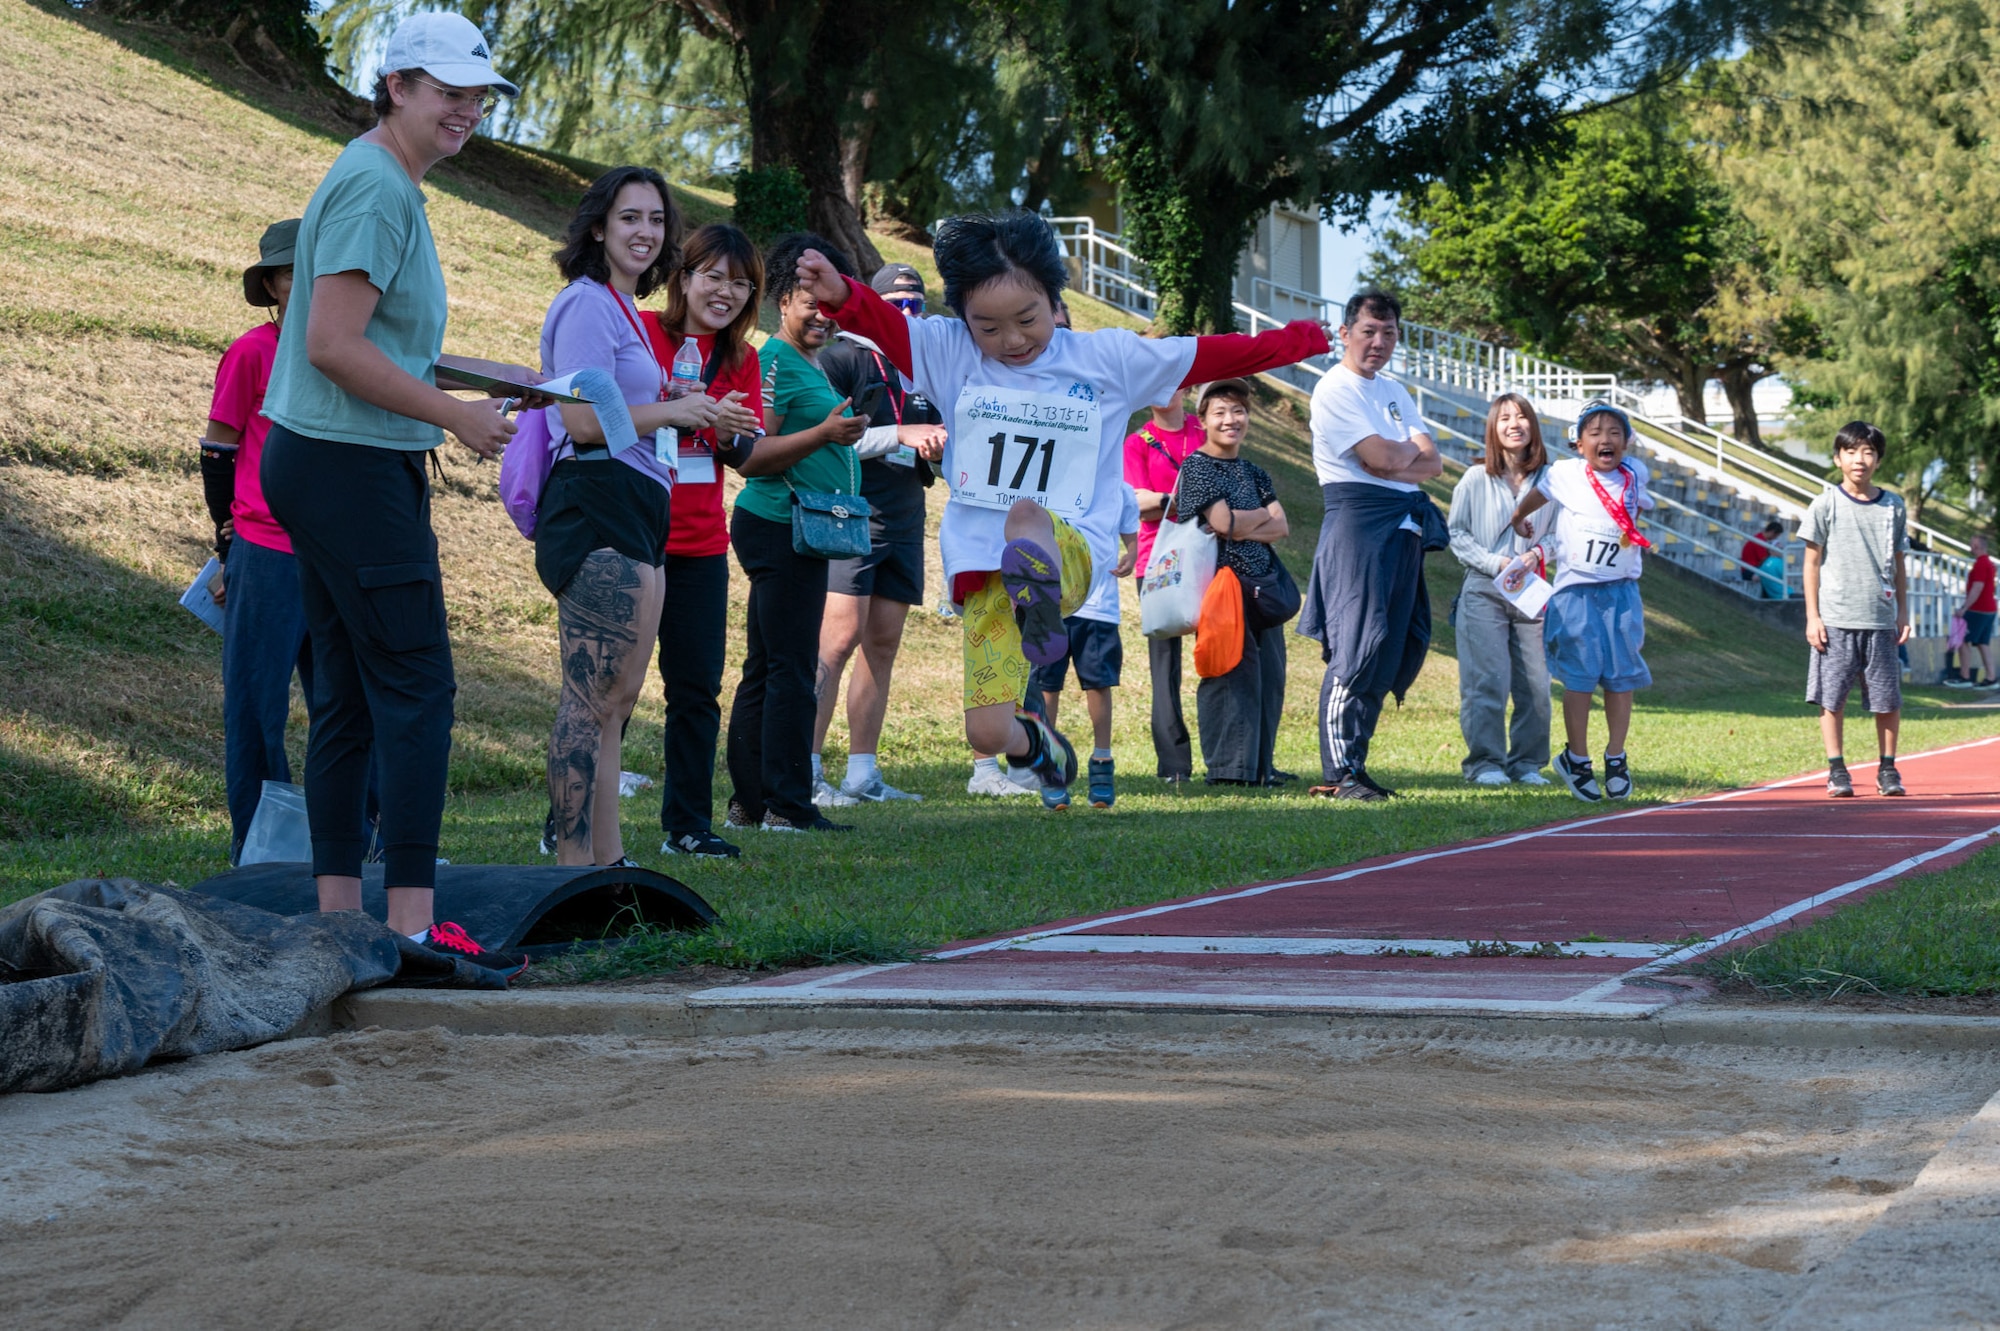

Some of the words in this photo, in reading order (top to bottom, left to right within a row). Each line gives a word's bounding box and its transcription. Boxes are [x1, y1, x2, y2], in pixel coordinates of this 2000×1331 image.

[973, 396, 1008, 414] Chatan
[1020, 403, 1039, 419] T2
[1043, 406, 1057, 421] T3
[1060, 407, 1075, 422] T5
[981, 412, 1001, 421] 2025
[1001, 414, 1033, 426] Kadena
[1033, 420, 1057, 430] Special
[1057, 422, 1089, 433] Olympics
[987, 431, 1056, 492] 171
[1585, 539, 1620, 567] 172
